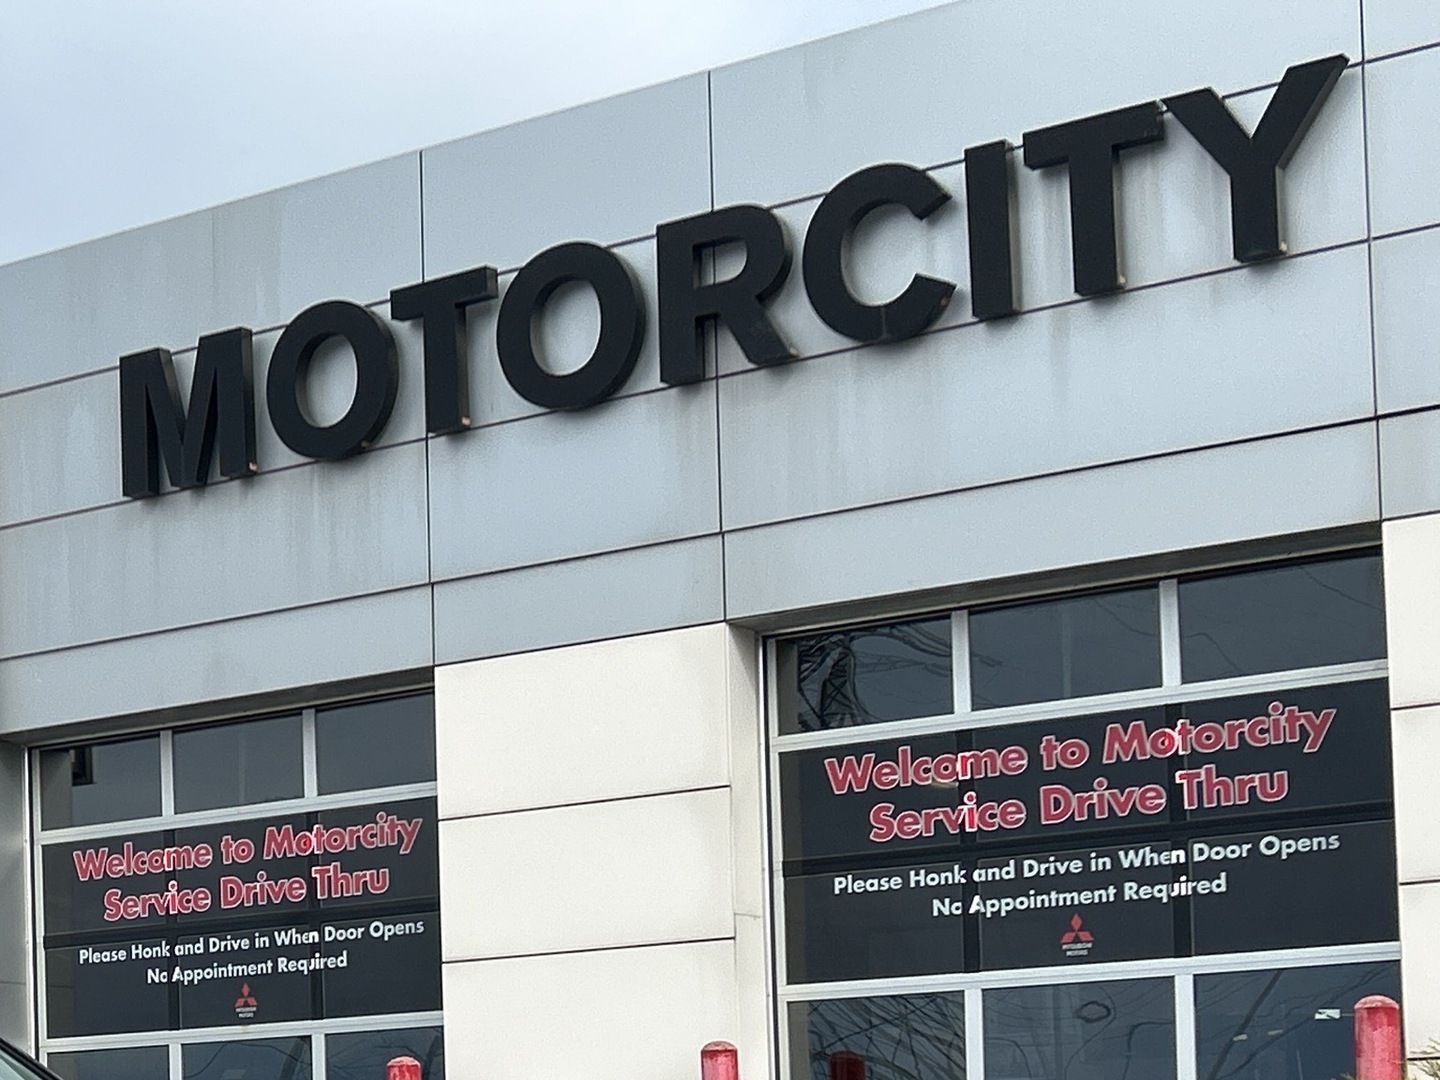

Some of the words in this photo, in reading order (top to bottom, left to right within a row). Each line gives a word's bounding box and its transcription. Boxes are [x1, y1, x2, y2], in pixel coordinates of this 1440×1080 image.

[119, 53, 1350, 498] MOTORCITY
[824, 744, 1028, 795] Welcome
[1040, 734, 1090, 772] to
[1102, 702, 1337, 765] Motorcity
[869, 791, 1027, 843] Service
[1039, 778, 1166, 826] Drive
[1174, 765, 1289, 807] Thru
[73, 840, 213, 882] Welcome
[221, 835, 255, 864] to
[262, 811, 423, 860] Motorcity
[833, 870, 903, 896] Please
[909, 863, 966, 889] Honk
[972, 859, 1016, 884] and
[1023, 854, 1083, 879] Drive
[1089, 851, 1111, 873] in
[1118, 846, 1187, 870] When
[1192, 839, 1253, 864] Door
[1259, 832, 1340, 860] Opens
[104, 880, 212, 922] Service
[220, 871, 307, 910] Drive
[312, 861, 390, 900] Thru
[932, 897, 964, 918] No
[968, 883, 1117, 921] Appointment
[1123, 872, 1227, 906] Required
[79, 945, 127, 965] Please
[131, 940, 171, 960] Honk
[175, 937, 204, 957] and
[209, 933, 251, 954] Drive
[255, 932, 269, 949] in
[274, 929, 319, 947] When
[324, 923, 364, 943] Door
[369, 919, 425, 940] Opens
[147, 967, 168, 984] No
[172, 958, 273, 986] Appointment
[278, 951, 348, 975] Required
